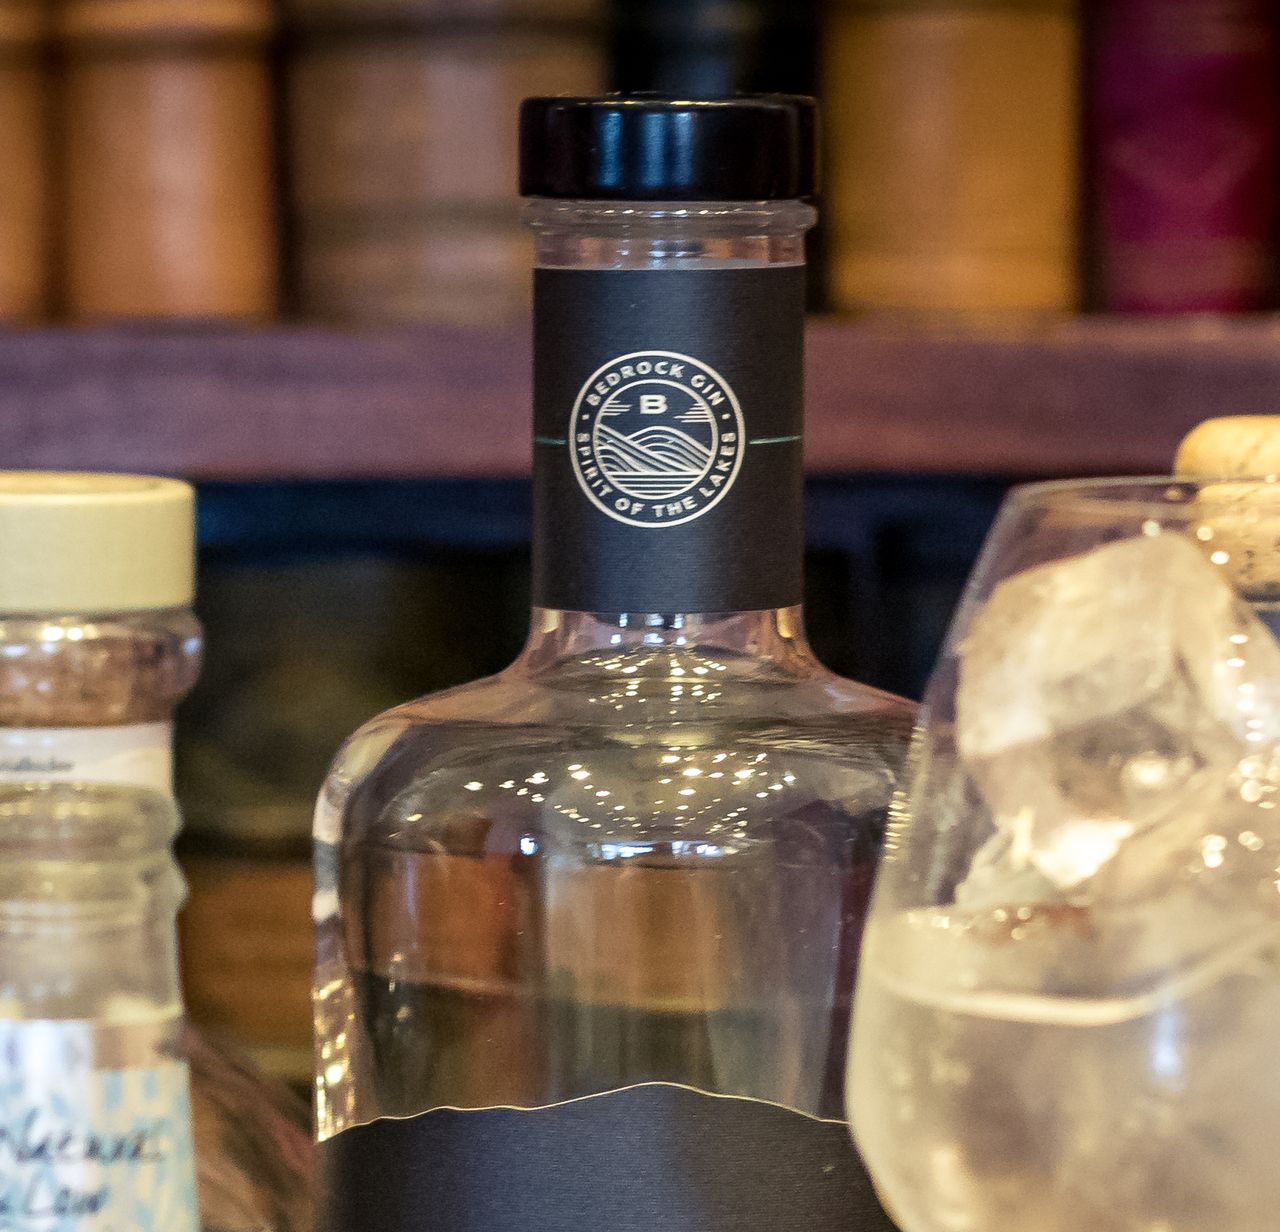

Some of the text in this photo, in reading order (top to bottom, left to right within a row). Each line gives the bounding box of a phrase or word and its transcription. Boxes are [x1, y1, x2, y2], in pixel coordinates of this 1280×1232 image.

[585, 361, 726, 407] BEDROCK GIN
[639, 394, 669, 415] B
[576, 432, 738, 518] SPIRIT OF THE LAKES
